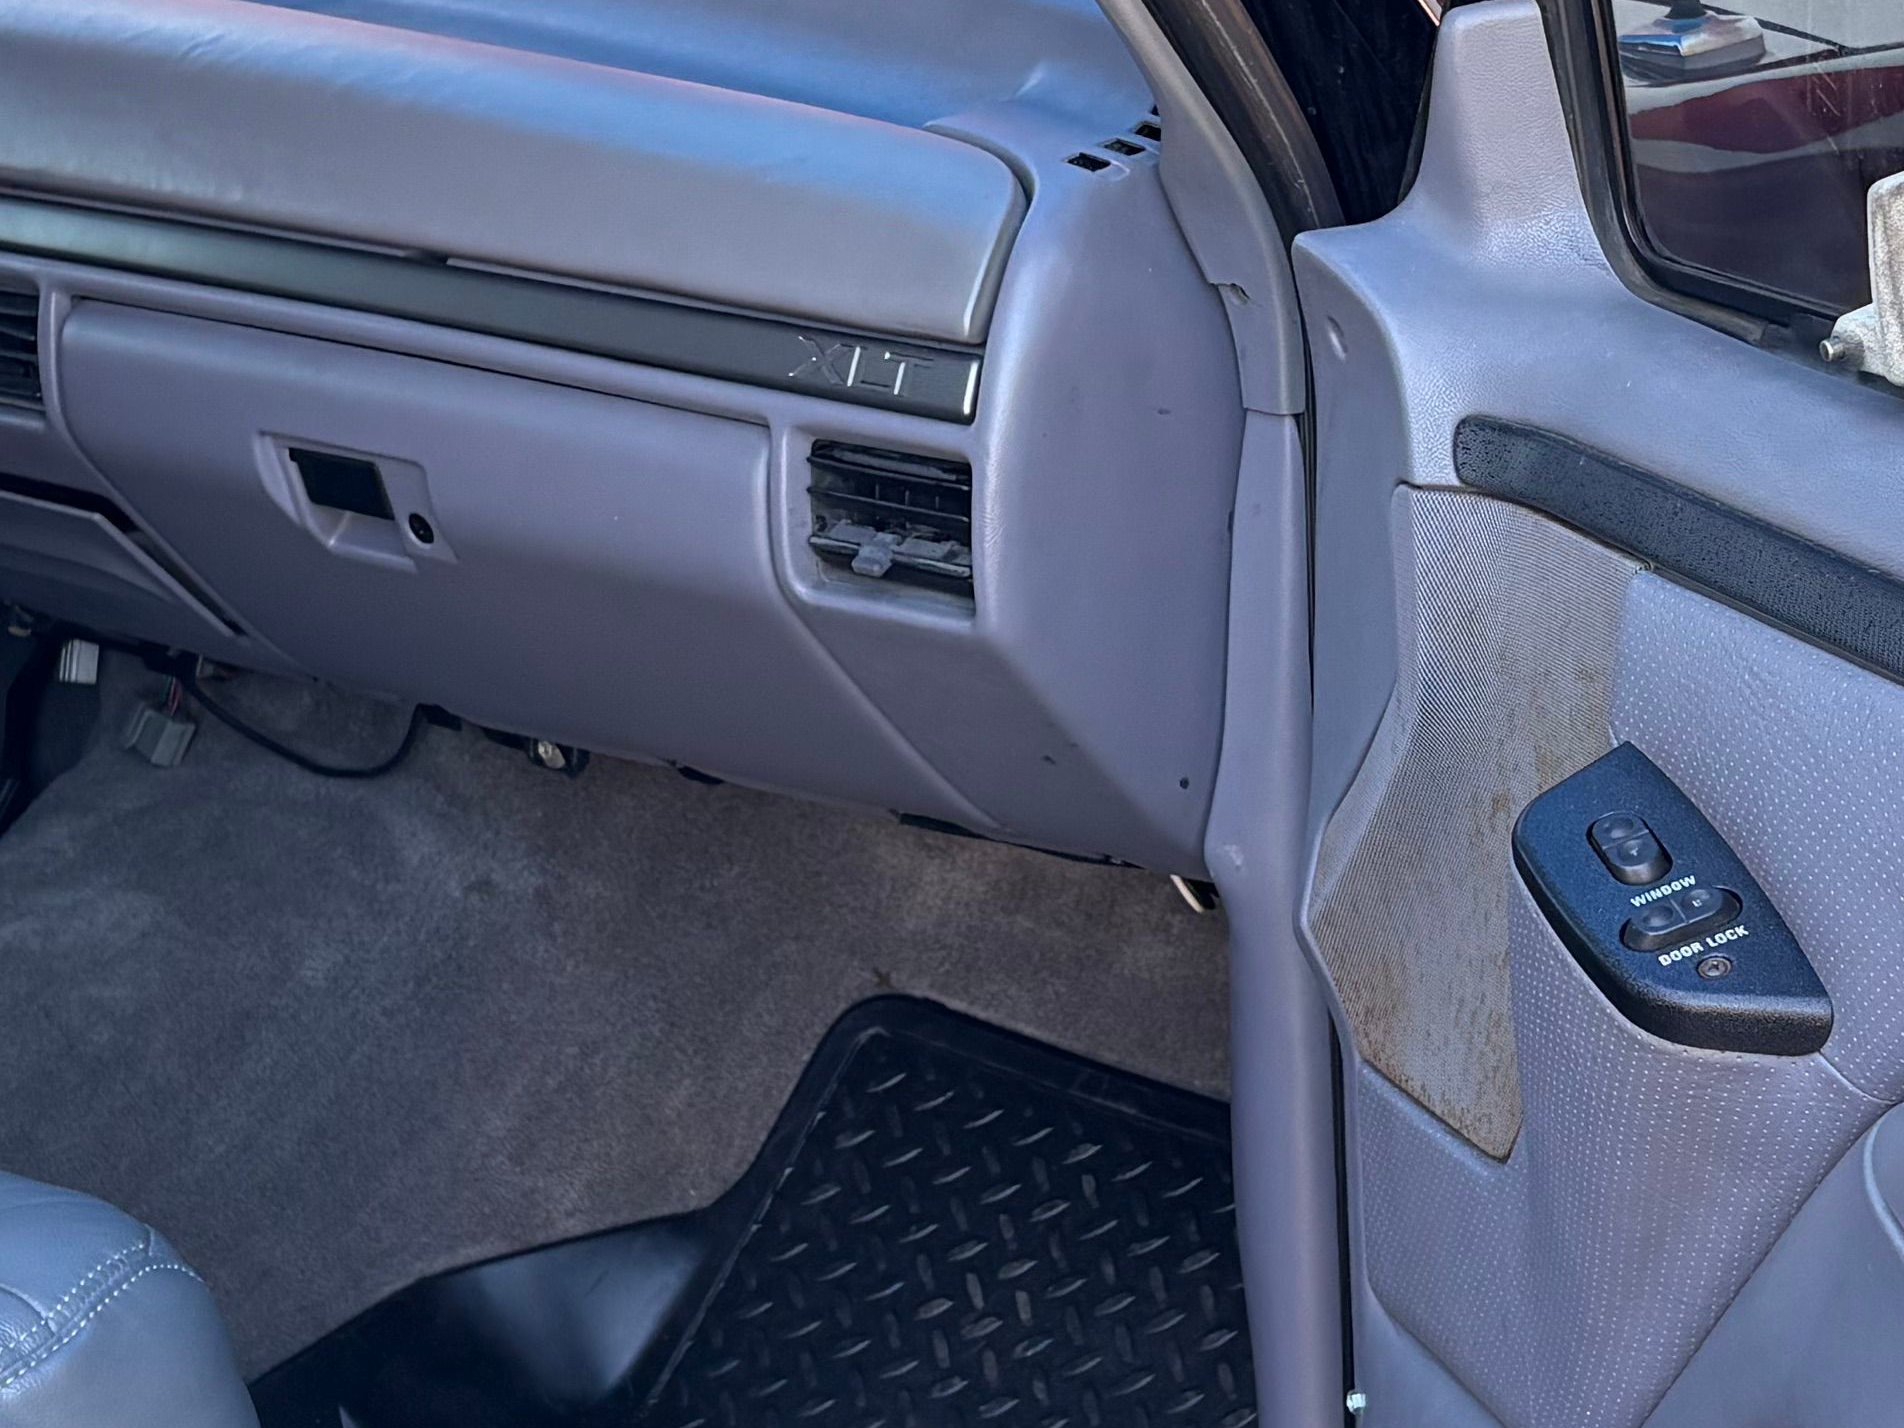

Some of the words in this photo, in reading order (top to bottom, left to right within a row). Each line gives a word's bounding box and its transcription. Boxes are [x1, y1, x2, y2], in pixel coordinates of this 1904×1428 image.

[789, 335, 935, 395] XLT
[1630, 875, 1696, 907] WINDOW
[1658, 942, 1704, 966] DOOR
[1705, 924, 1749, 947] LOCK
